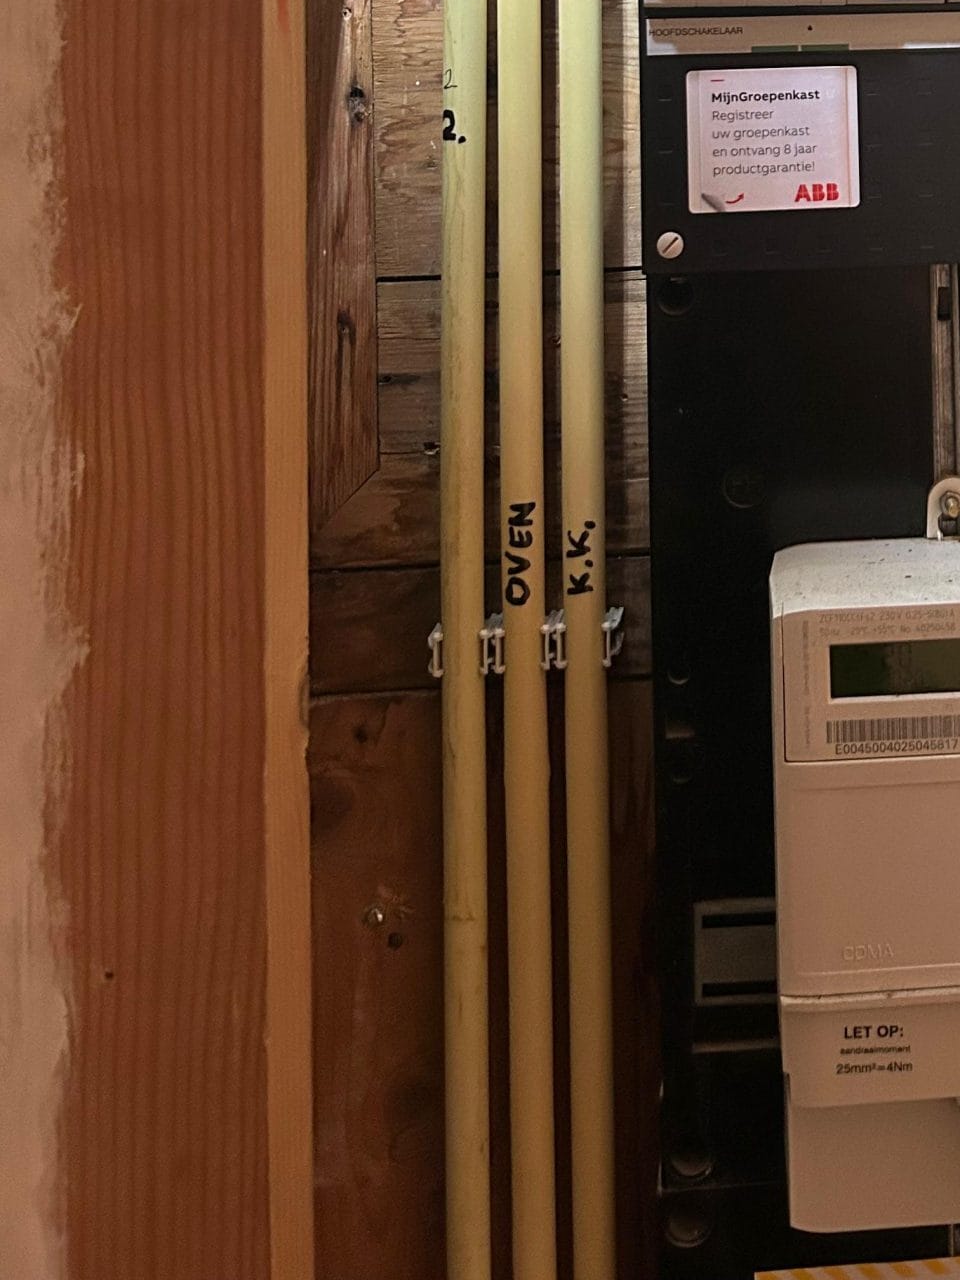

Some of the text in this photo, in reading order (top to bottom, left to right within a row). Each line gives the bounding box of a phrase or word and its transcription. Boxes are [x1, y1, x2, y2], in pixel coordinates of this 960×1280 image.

[649, 26, 743, 37] HOOFDSCHAKELAAR
[711, 89, 821, 105] MijnGroepenkast
[712, 109, 774, 123] Registreer
[712, 126, 811, 141] uw groepenkast
[712, 144, 817, 158] en ontvang 8 jaar
[712, 161, 815, 177] productgarantie!
[794, 182, 840, 202] ABB
[505, 502, 536, 606] OVEN
[566, 520, 597, 595] K.K.
[843, 1025, 905, 1039] LET OP:
